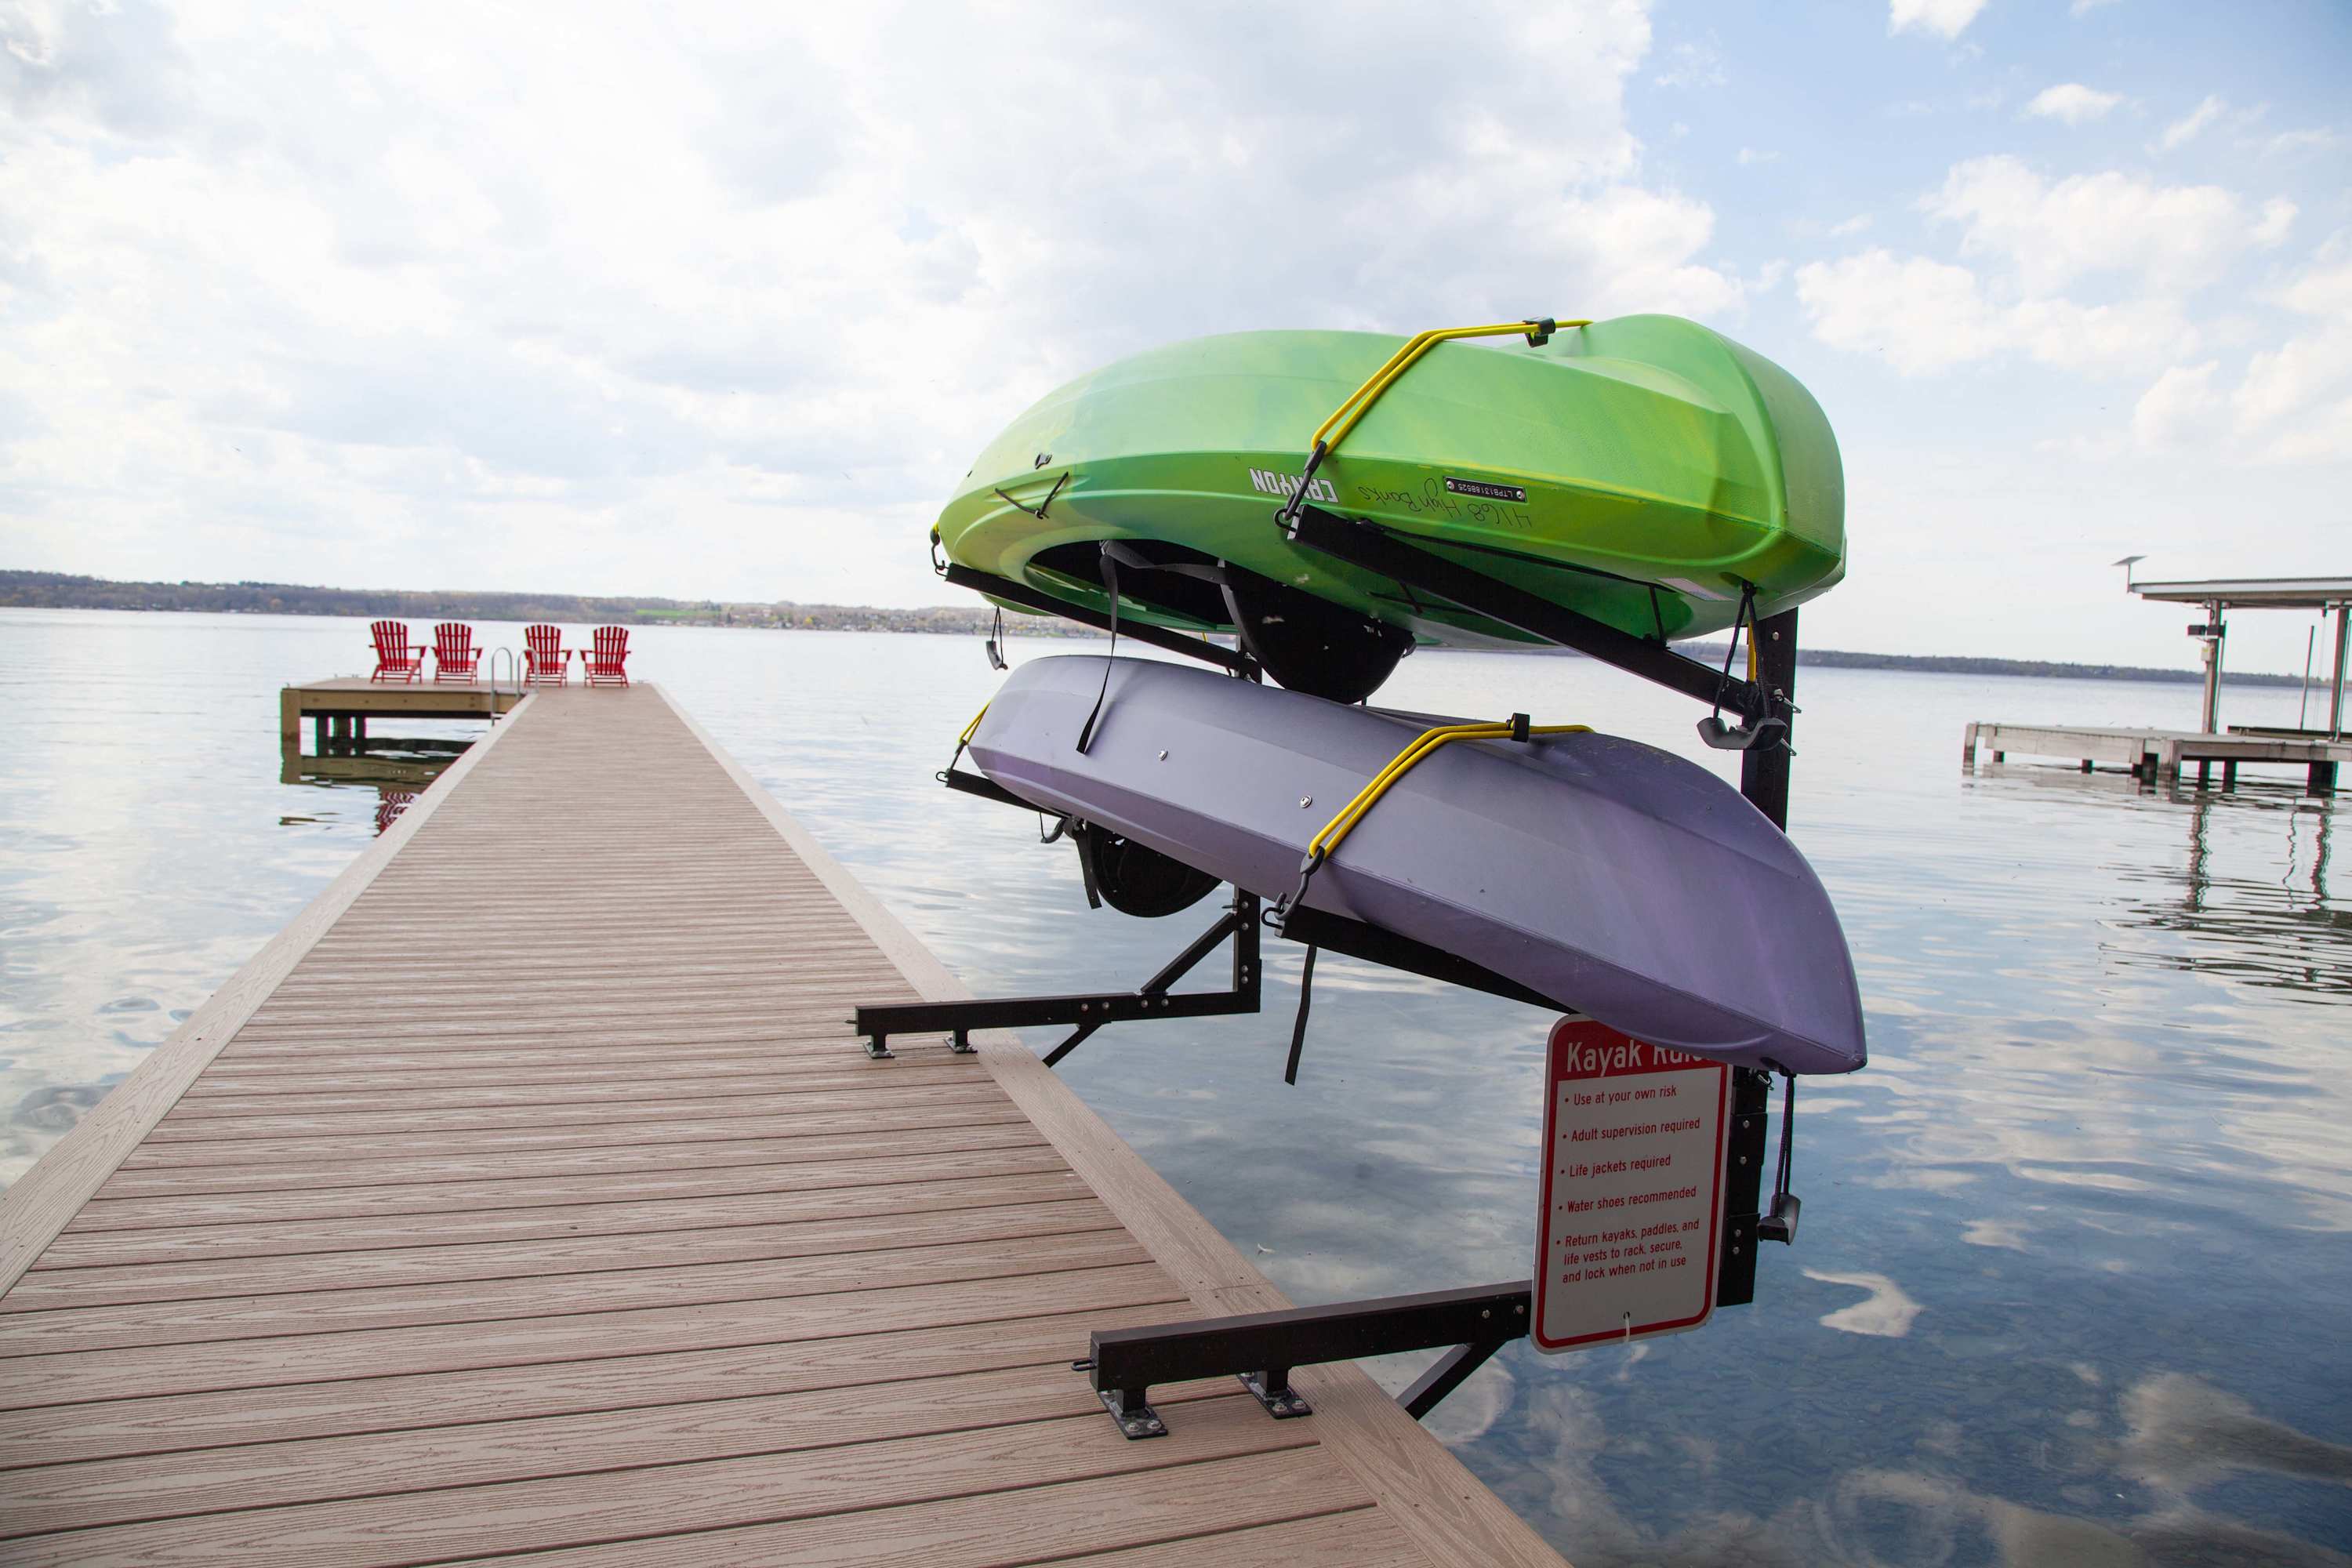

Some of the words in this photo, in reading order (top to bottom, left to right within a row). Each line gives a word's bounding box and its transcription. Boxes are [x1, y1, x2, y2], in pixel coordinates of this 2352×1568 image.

[1249, 467, 1339, 503] CANYON
[1417, 477, 1462, 518] High
[1358, 486, 1422, 512] Banks
[1467, 503, 1533, 528] 4168
[1567, 1040, 1642, 1077] Kayak
[1573, 1093, 1592, 1106] Use
[1595, 1091, 1606, 1104] at
[1608, 1090, 1632, 1106] your
[1635, 1088, 1656, 1099] own
[1659, 1084, 1677, 1098] risk
[1570, 1129, 1598, 1143] Adult
[1601, 1121, 1657, 1141] supervision
[1660, 1117, 1700, 1134] required
[1569, 1164, 1588, 1178] Life
[1591, 1159, 1628, 1180] jackets
[1630, 1154, 1671, 1172] required
[1567, 1200, 1594, 1214] Water
[1597, 1196, 1624, 1210] shoes
[1628, 1185, 1697, 1206] recommended
[1564, 1233, 1599, 1248] Return
[1602, 1227, 1638, 1245] kayaks,
[1640, 1222, 1680, 1241] paddles,
[1682, 1218, 1700, 1232] and
[1563, 1252, 1580, 1267] life
[1583, 1249, 1608, 1261] vests
[1610, 1249, 1621, 1259] to
[1650, 1240, 1682, 1254] secure,
[1562, 1270, 1581, 1284] and
[1584, 1266, 1606, 1281] lock
[1609, 1263, 1636, 1276] when
[1639, 1259, 1656, 1272] not
[1658, 1258, 1668, 1270] in
[1670, 1256, 1687, 1269] use
